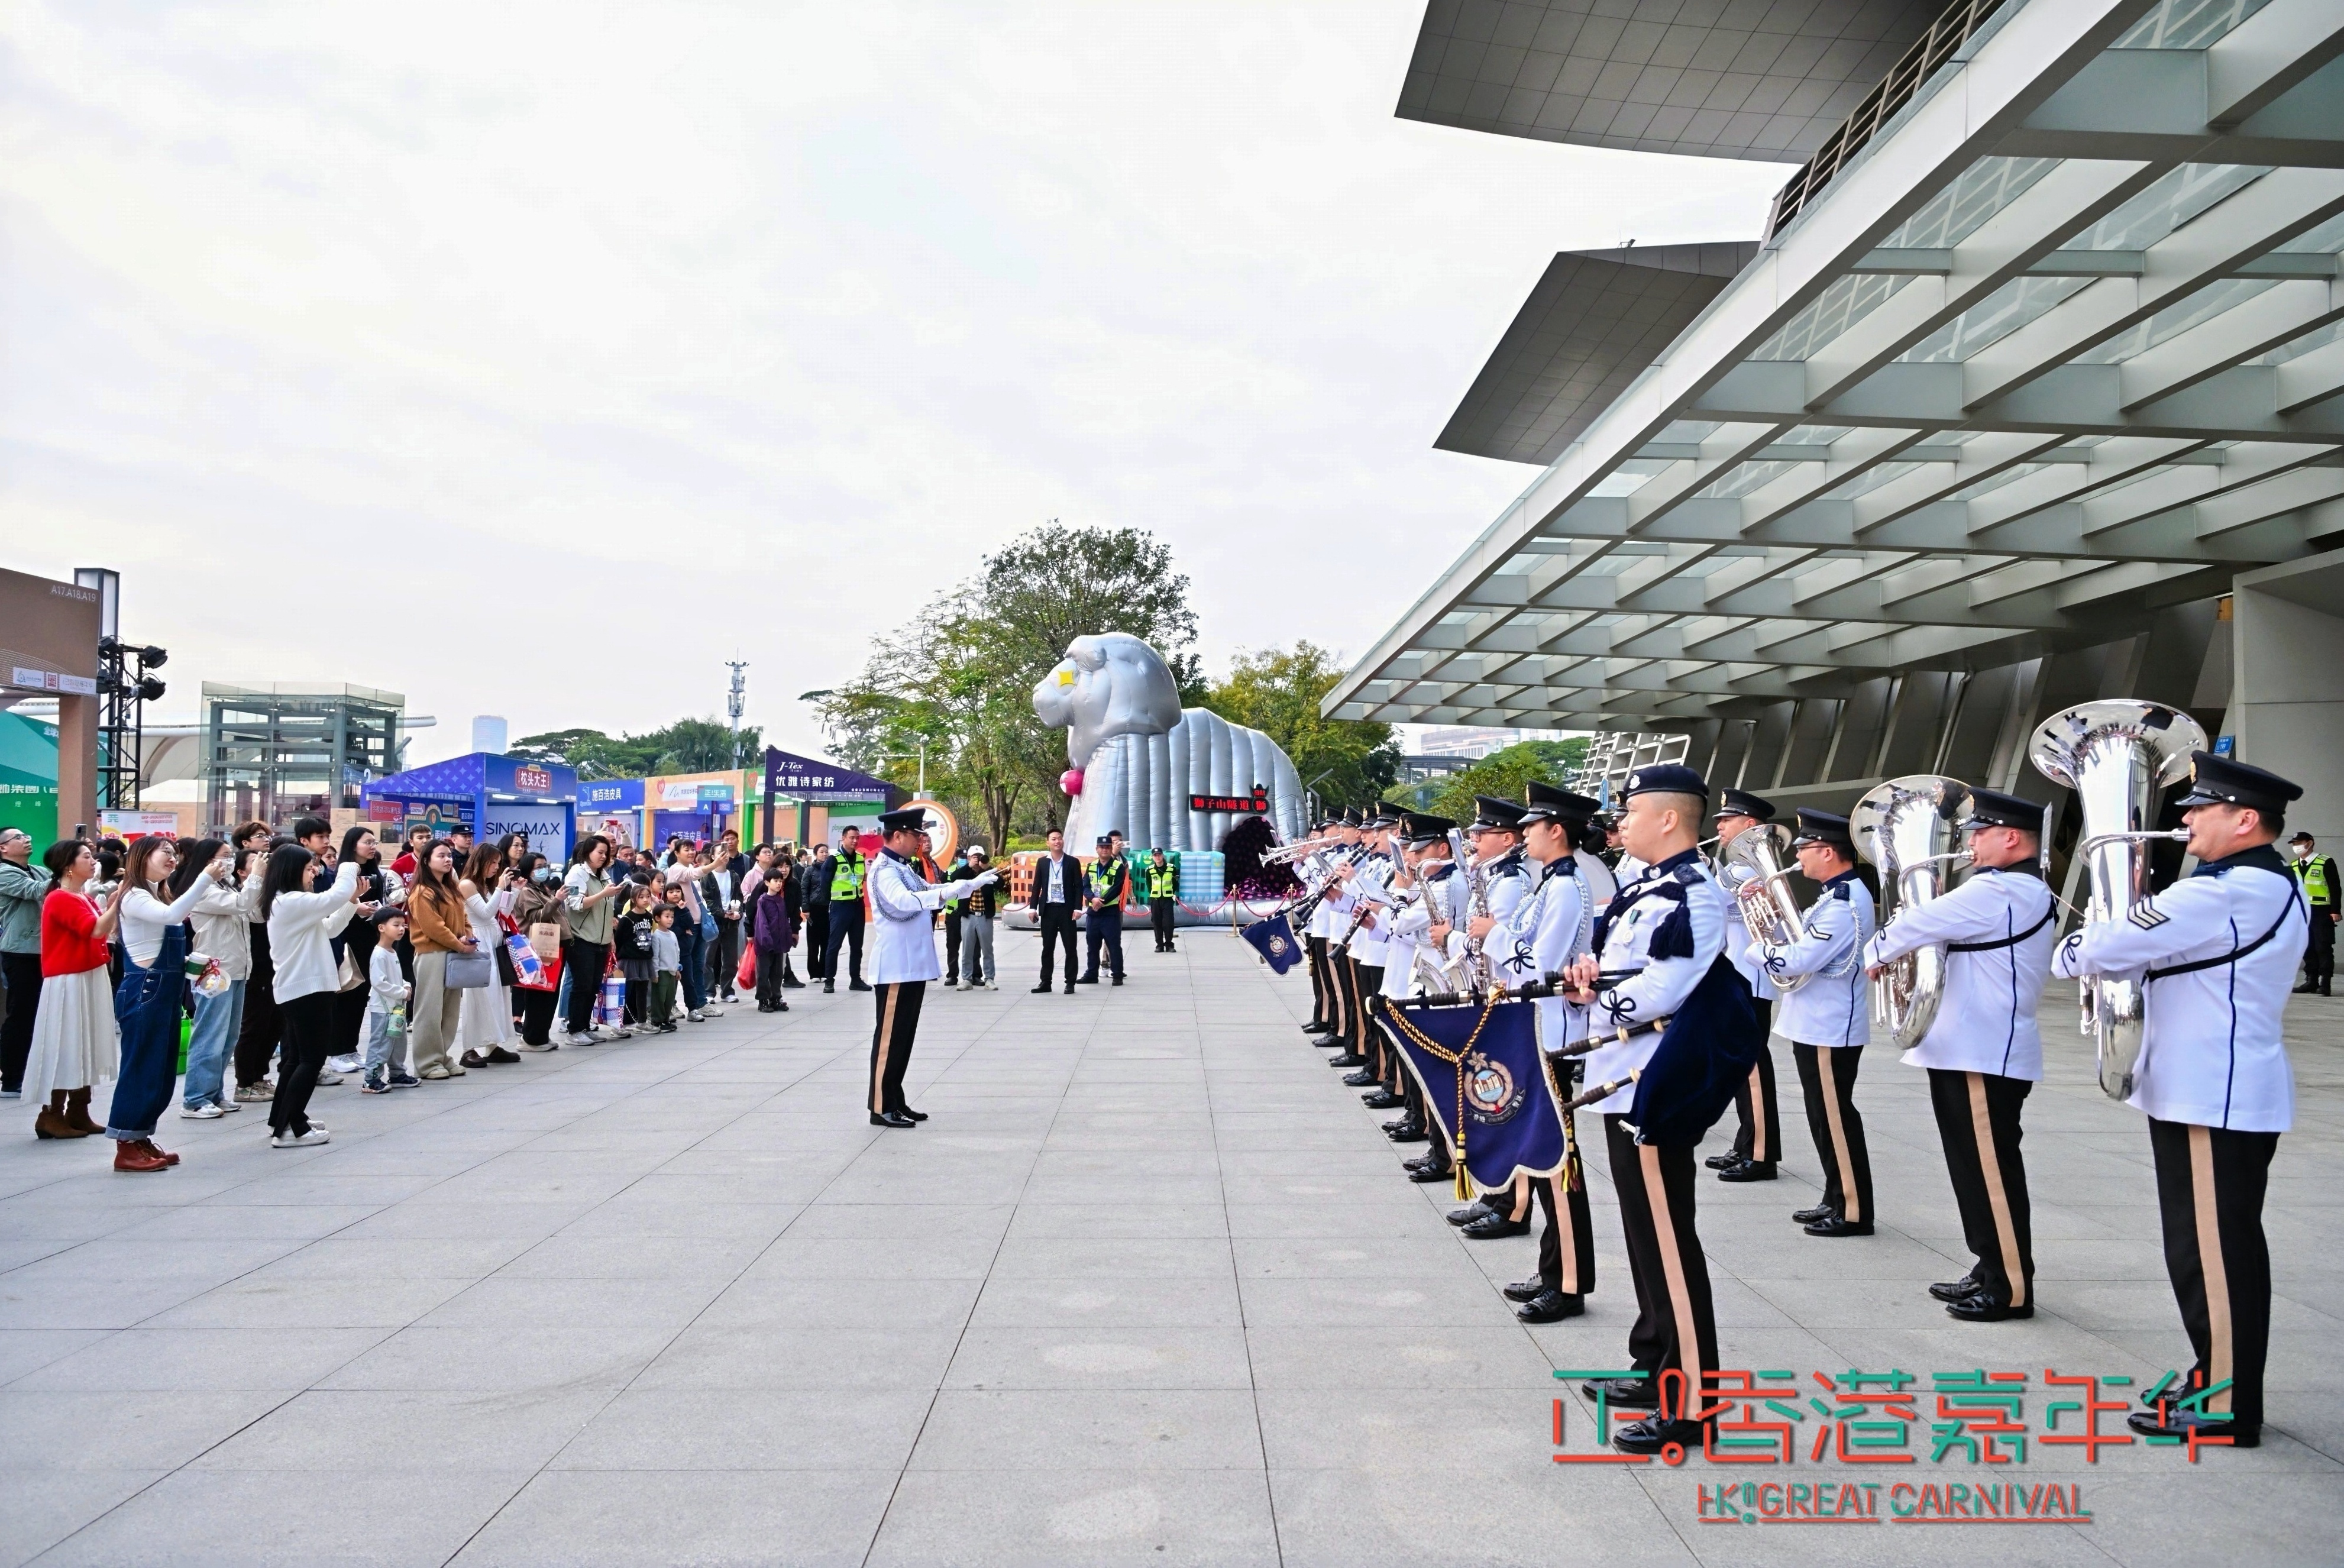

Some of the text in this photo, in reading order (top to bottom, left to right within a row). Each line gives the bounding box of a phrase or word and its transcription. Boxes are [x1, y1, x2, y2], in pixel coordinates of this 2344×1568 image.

[51, 585, 96, 602] A17.A18.A19
[777, 762, 803, 772] J-Tex
[520, 770, 547, 787] 枕头大王
[775, 776, 835, 787] 优雅诗家纺
[592, 787, 622, 801] 施百浩皮具
[1194, 797, 1249, 810] 獅子山隧道
[486, 822, 560, 835] SINOMAX
